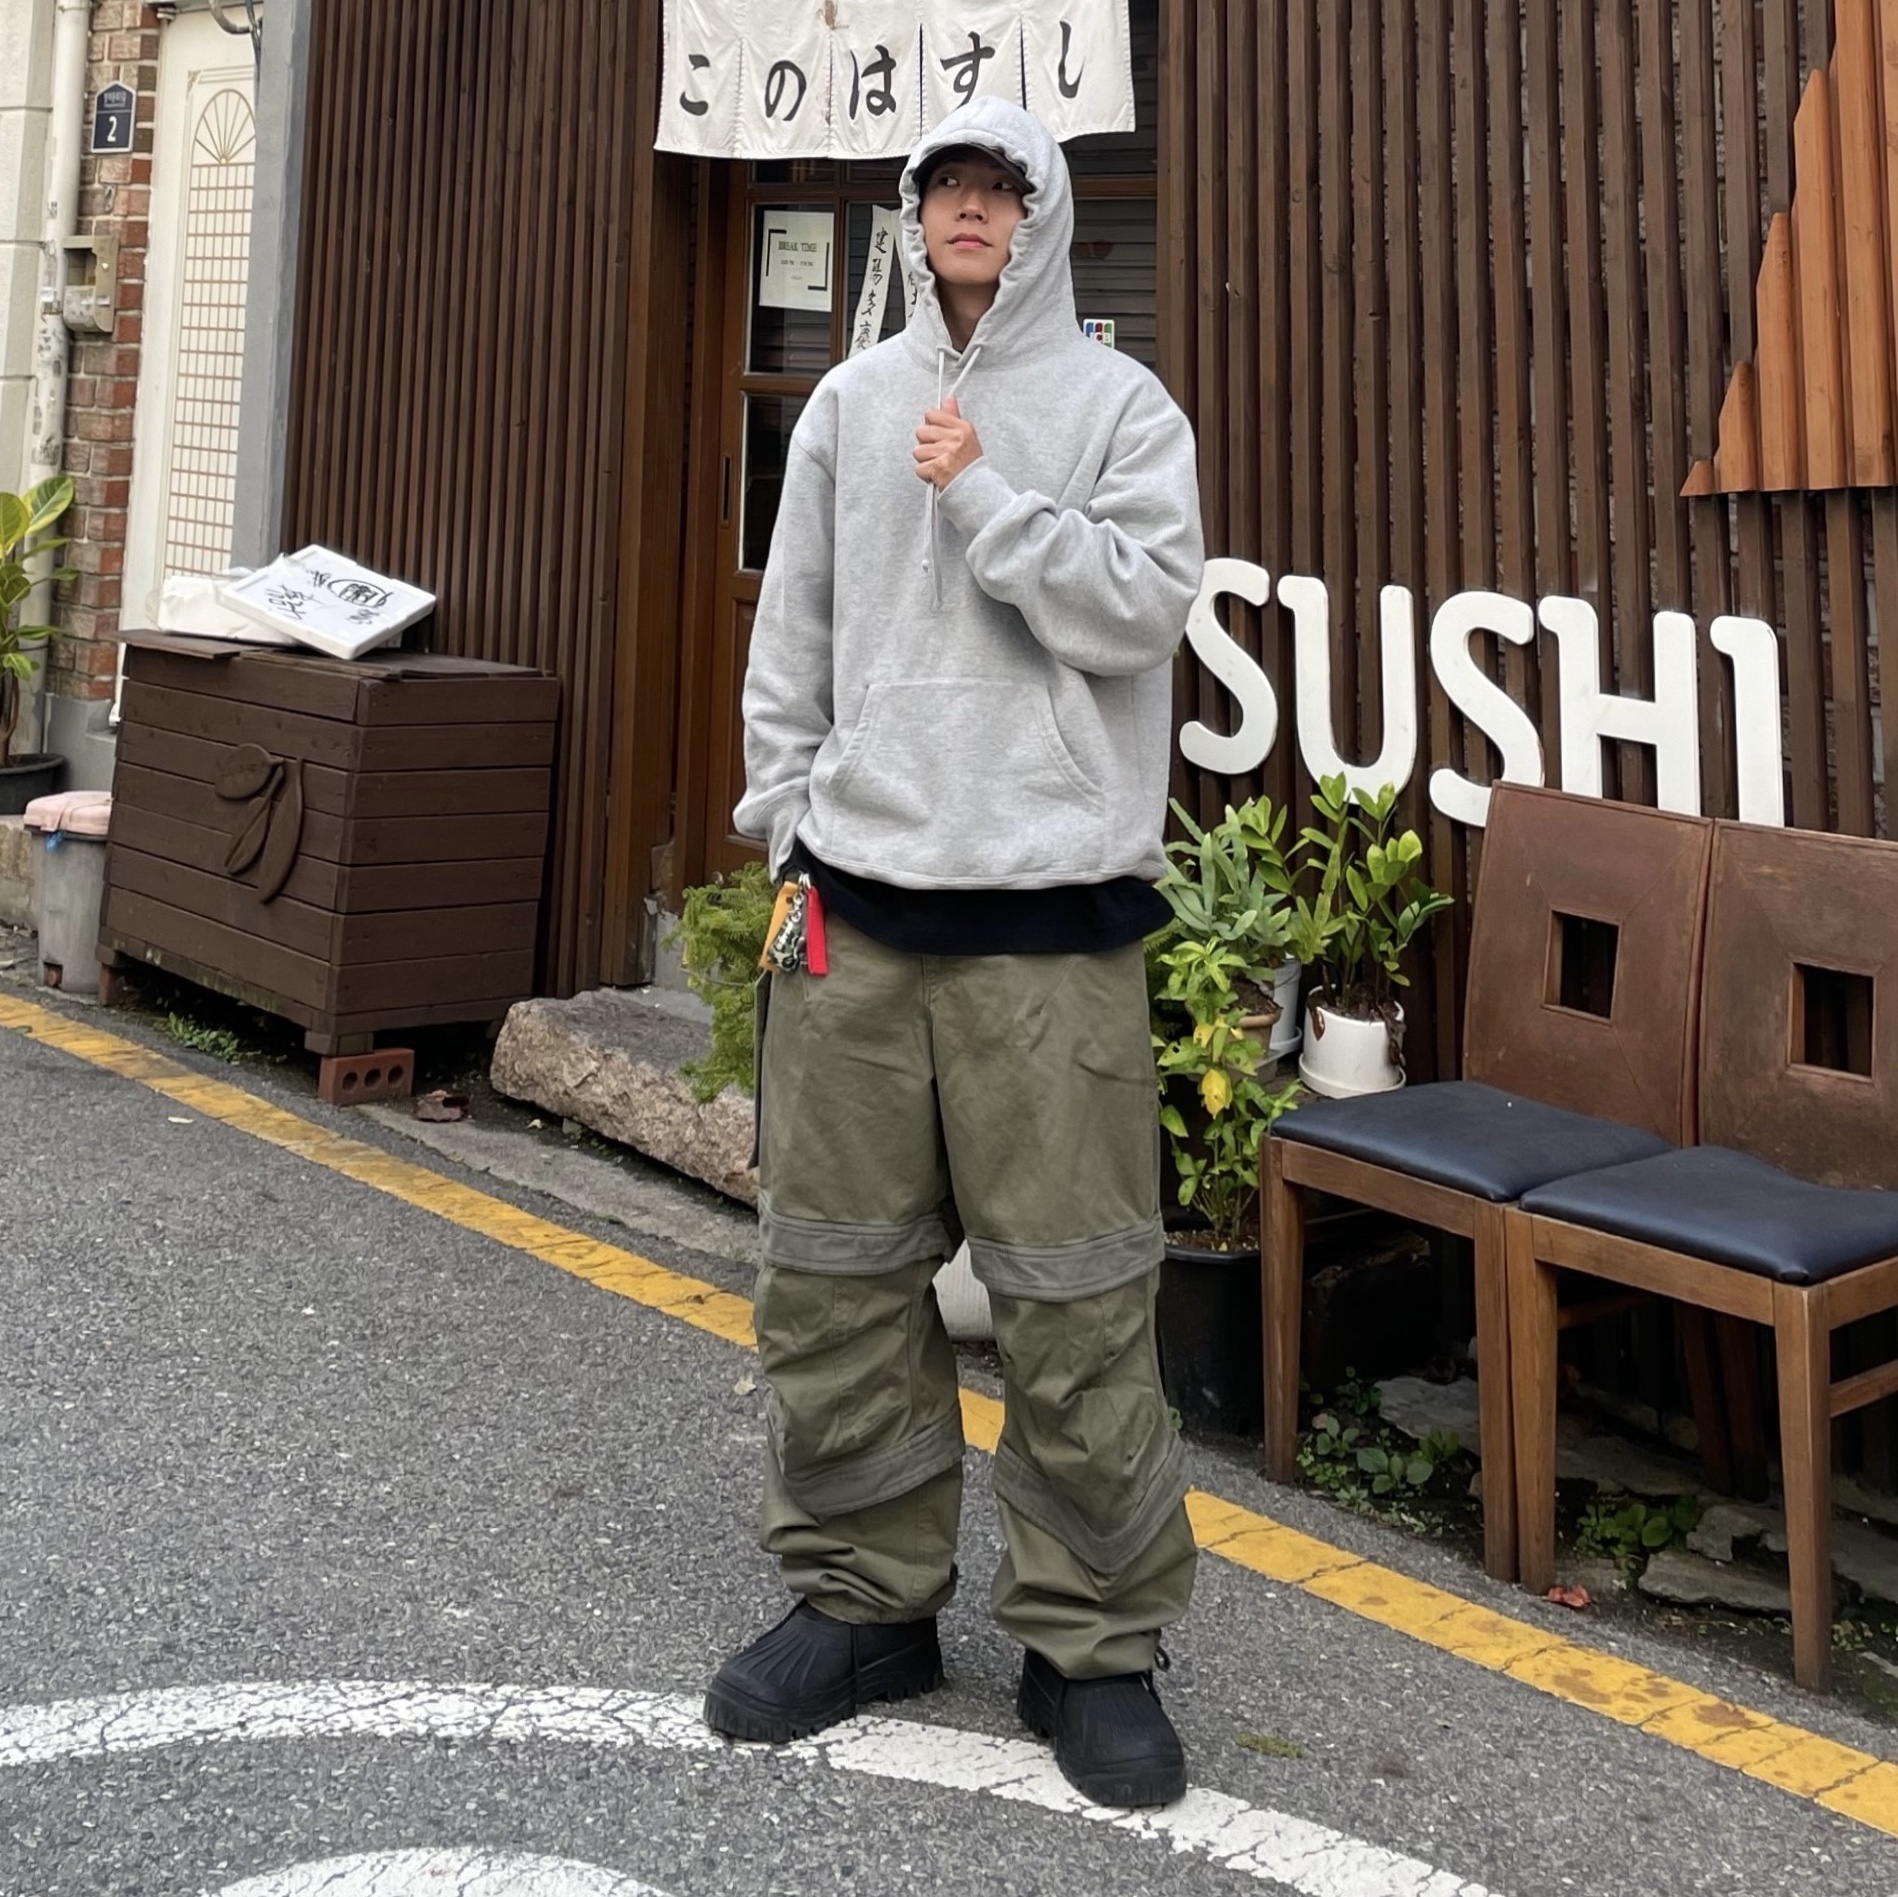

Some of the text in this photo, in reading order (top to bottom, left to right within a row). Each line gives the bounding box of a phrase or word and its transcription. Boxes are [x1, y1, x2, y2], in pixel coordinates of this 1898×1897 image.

[680, 21, 1084, 121] このはすし
[106, 115, 117, 142] 2
[778, 240, 817, 253] BREAK TIME
[1179, 557, 1784, 827] SUSHI
